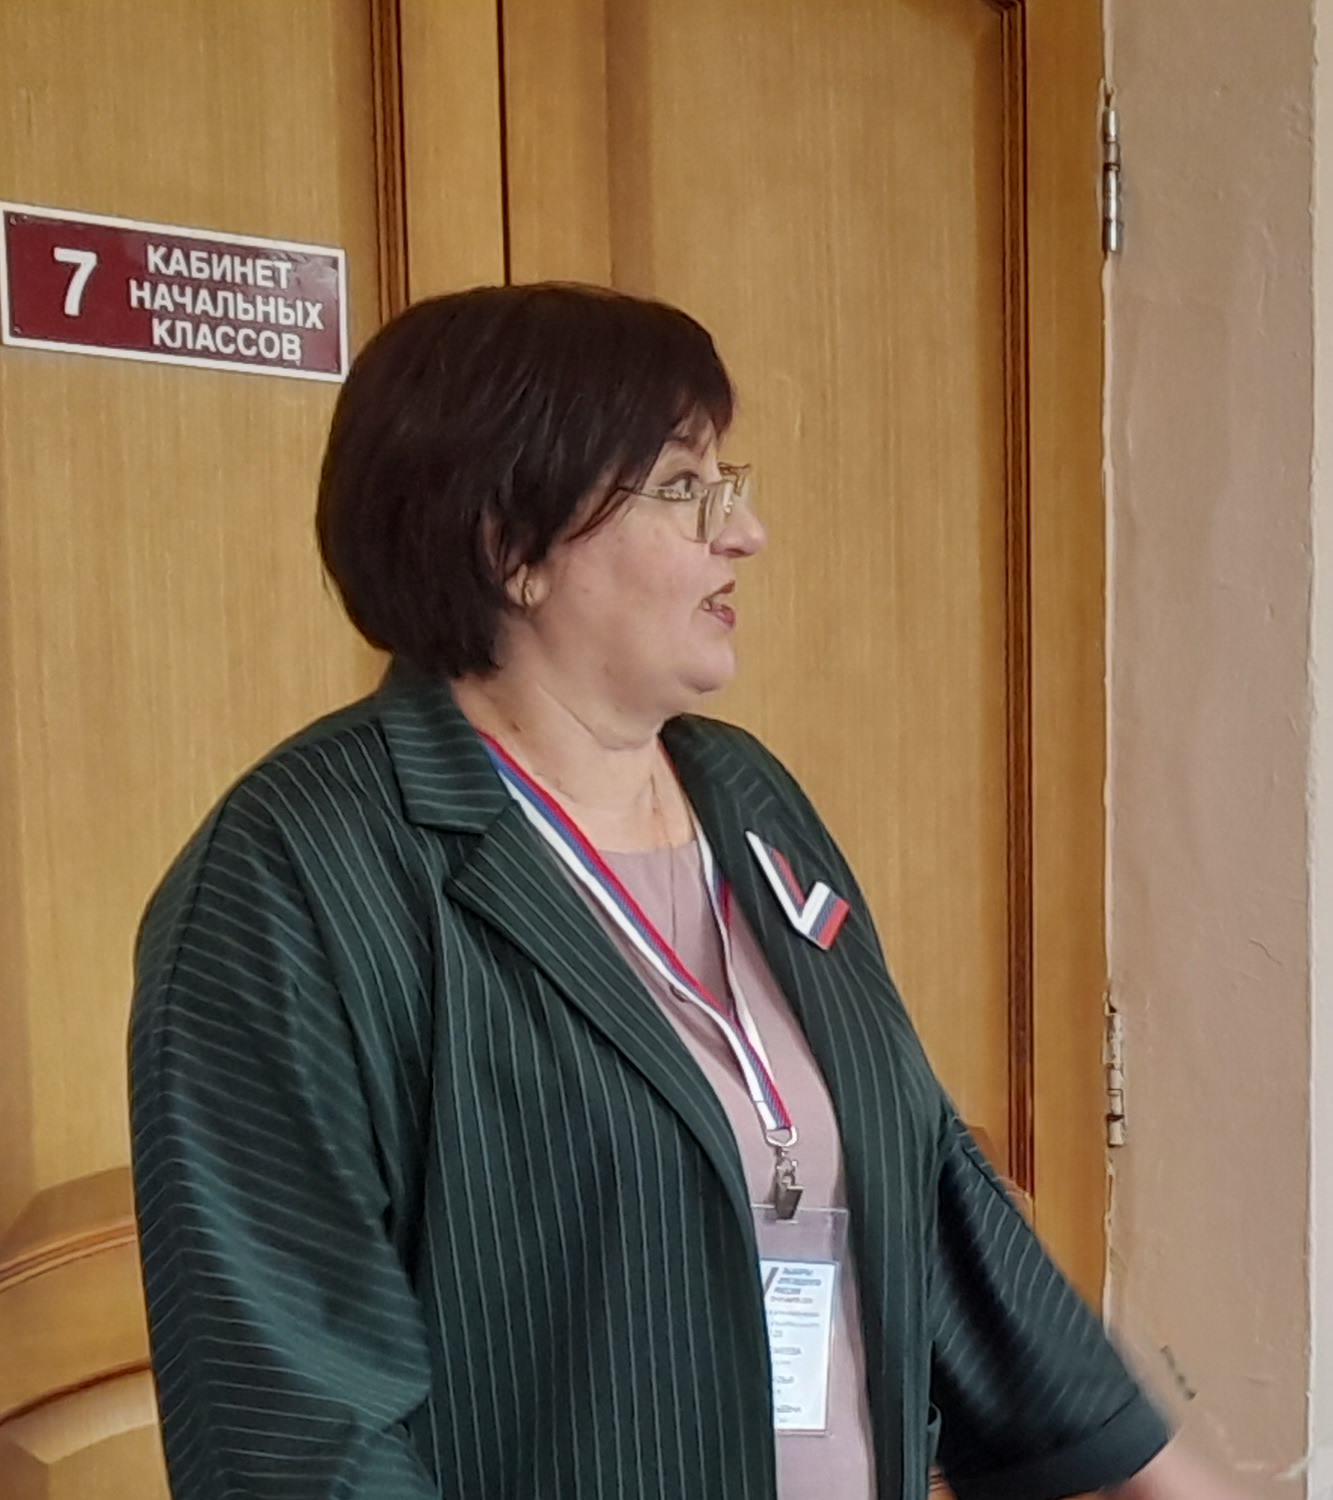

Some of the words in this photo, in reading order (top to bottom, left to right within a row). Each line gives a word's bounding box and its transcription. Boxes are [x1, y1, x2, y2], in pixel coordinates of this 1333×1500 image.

[53, 247, 98, 317] 7
[147, 244, 292, 290] КАБИНЕТ
[129, 278, 325, 330] НАЧАЛЬНЫХ
[151, 317, 302, 362] КЛАССОВ
